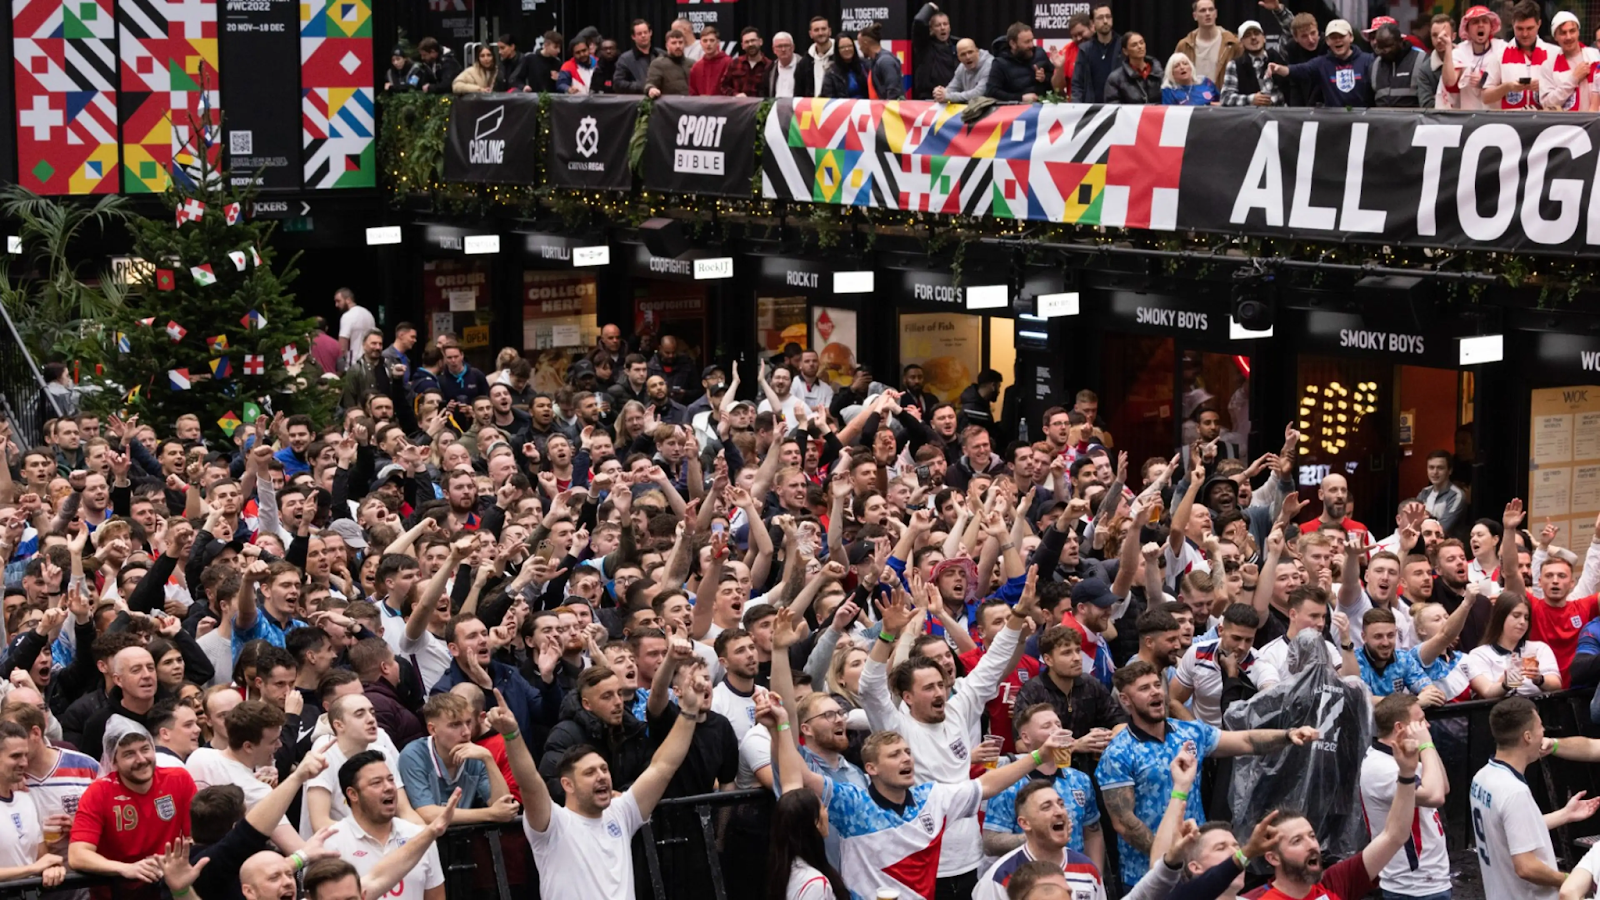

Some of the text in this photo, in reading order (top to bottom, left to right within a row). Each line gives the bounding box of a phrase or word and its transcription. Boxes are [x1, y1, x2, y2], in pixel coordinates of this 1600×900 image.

[226, 2, 270, 11] #WC2022
[842, 7, 889, 20] ALL TOGETHER
[1035, 3, 1090, 16] ALL TOGETHER
[688, 11, 718, 22] TOGETHER
[226, 23, 237, 32] 20
[270, 23, 285, 32] DEC
[676, 114, 728, 148] SPORT
[469, 139, 505, 164] CARLING
[568, 162, 605, 171] CHIVAS REGAL
[677, 154, 720, 170] BIBLE
[1229, 120, 1387, 233] ALL
[435, 272, 485, 287] ORDER
[786, 271, 819, 288] ROCK IT
[528, 283, 595, 299] COLLECT
[914, 283, 933, 300] FOR
[542, 299, 582, 312] HERE
[1136, 306, 1208, 330] SMOKY BOYS
[904, 321, 955, 332] Fillet of Fish
[466, 331, 488, 344] OPEN
[1339, 328, 1424, 354] SMOKY BOYS
[1563, 389, 1589, 403] WOK
[113, 804, 139, 832] 19
[1473, 806, 1491, 867] 9
